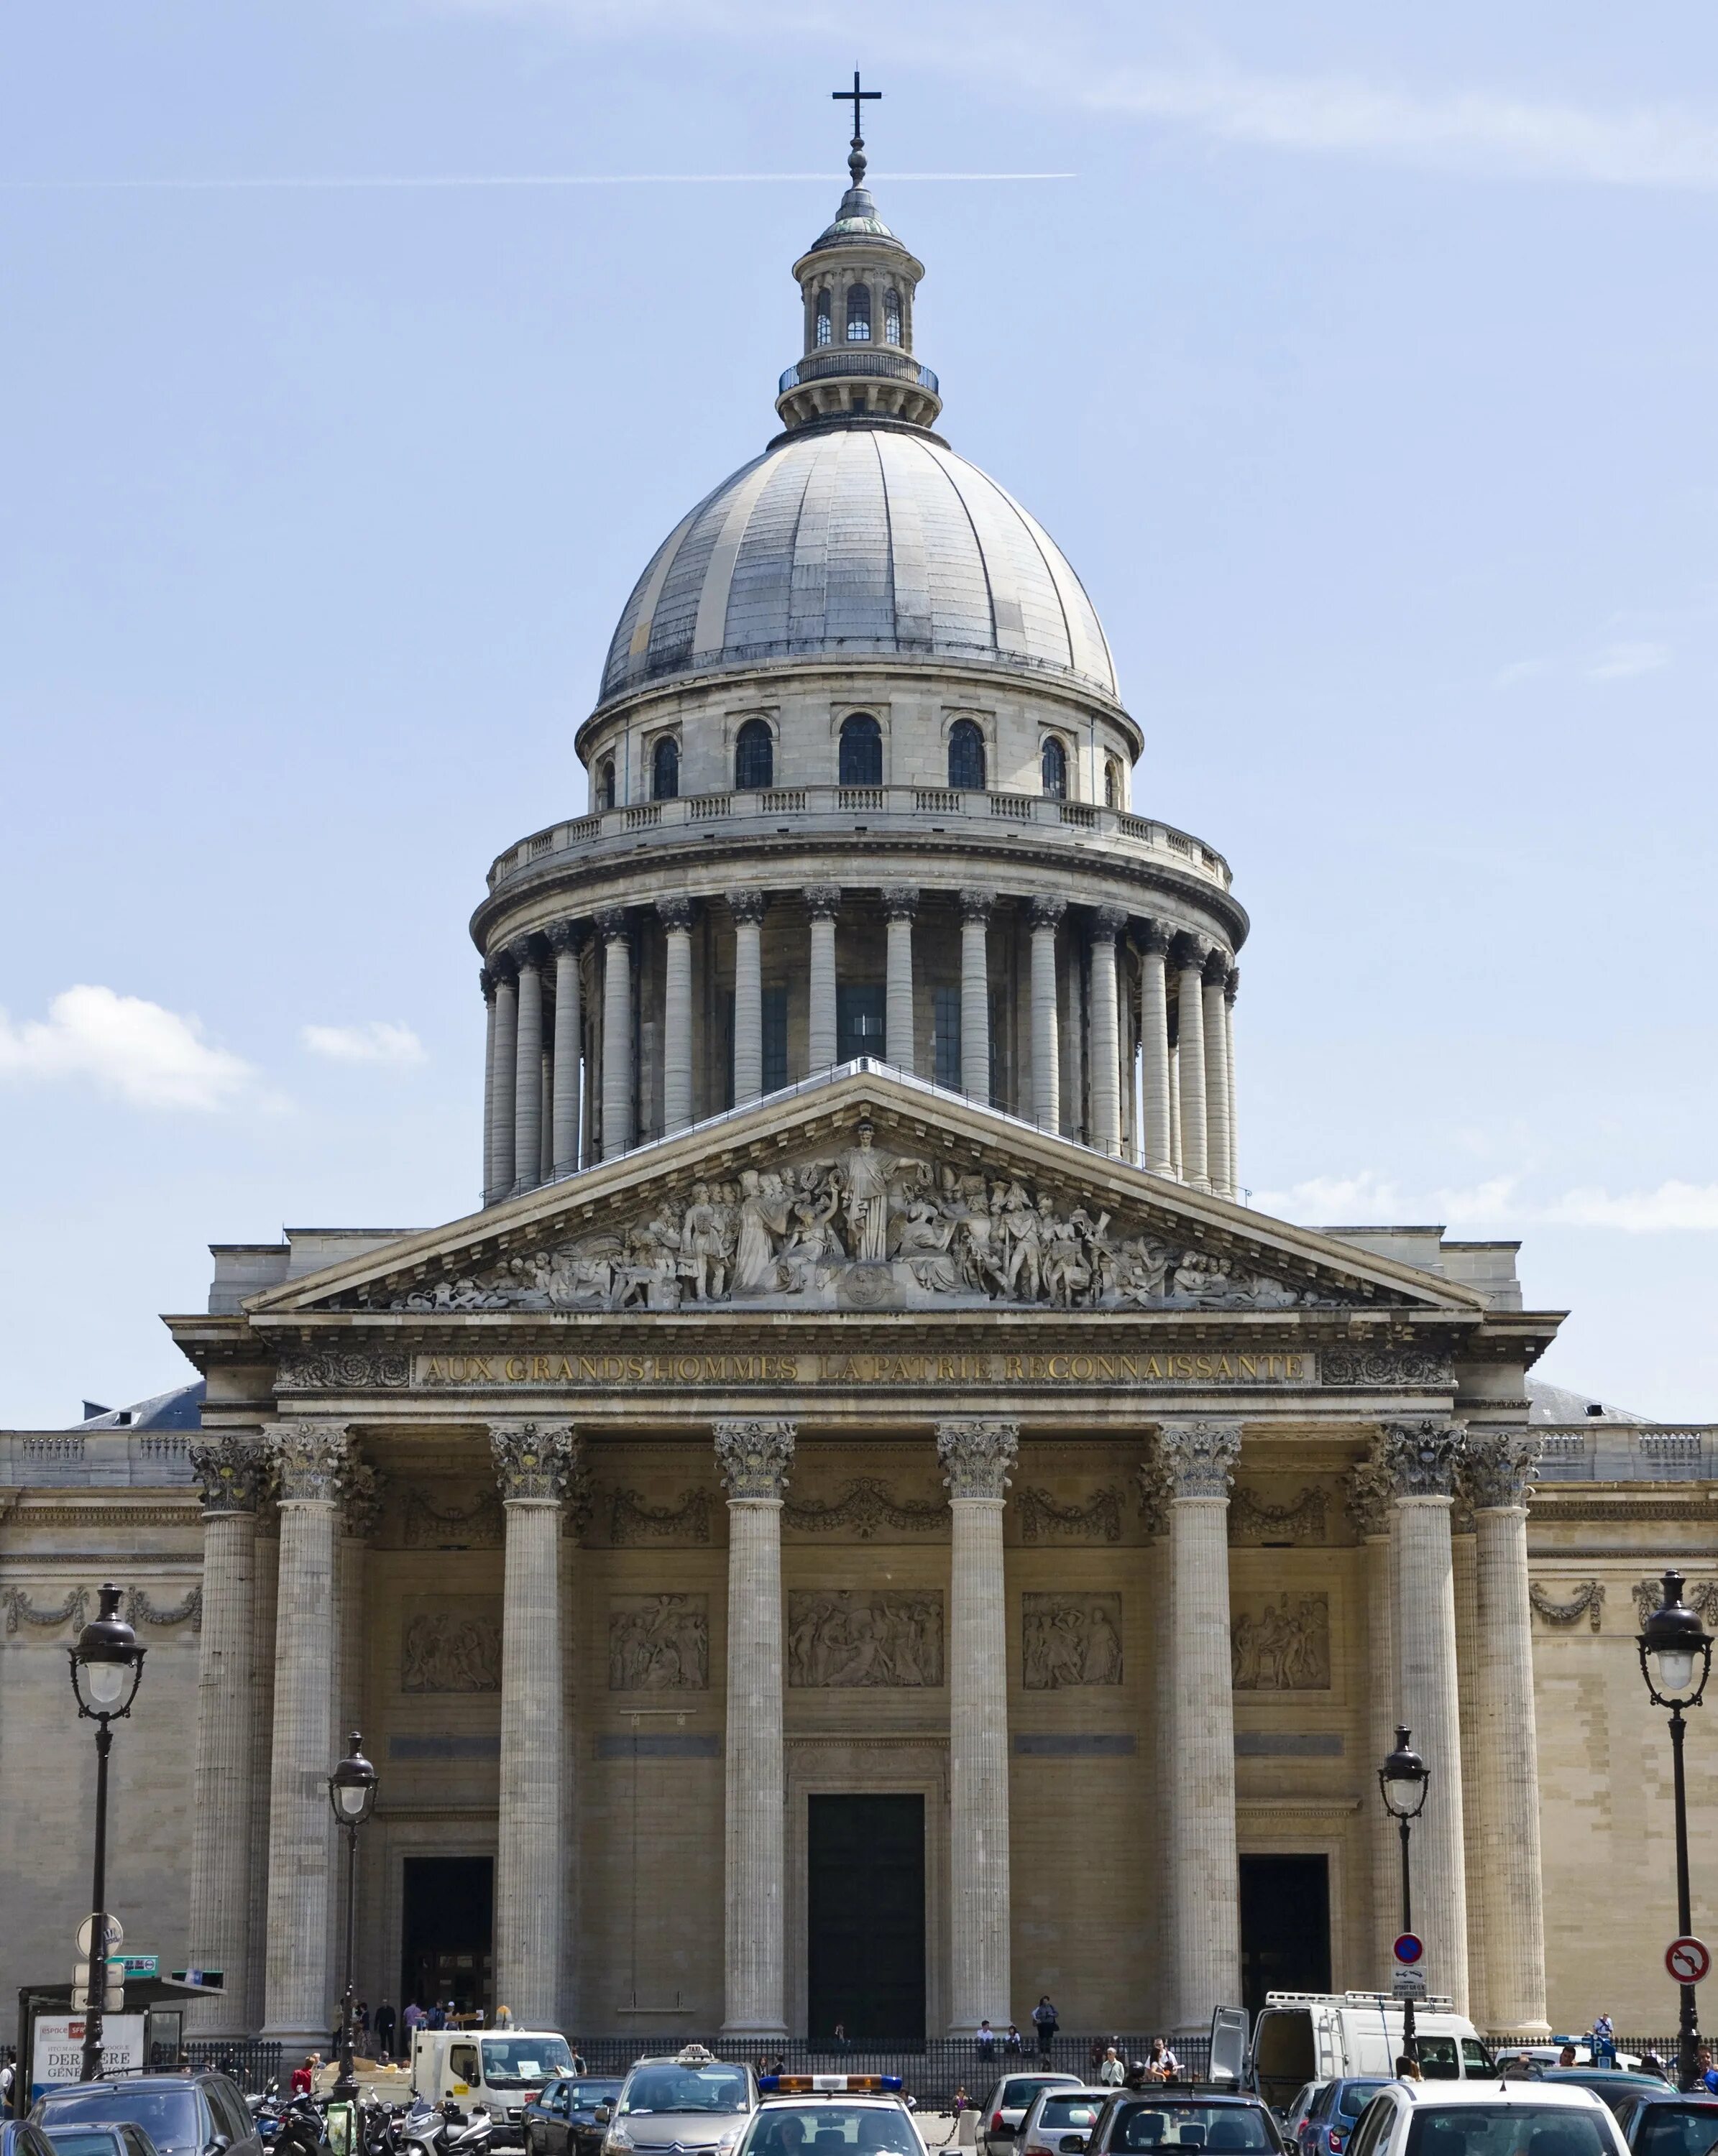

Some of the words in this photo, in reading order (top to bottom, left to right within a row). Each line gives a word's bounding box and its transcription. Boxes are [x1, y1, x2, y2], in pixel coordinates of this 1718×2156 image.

[423, 1355, 496, 1381] AUX
[505, 1355, 644, 1381] GRANDS
[652, 1355, 798, 1381] HOMMES
[818, 1355, 862, 1381] LA
[872, 1355, 993, 1381] PATRIE
[1004, 1355, 1304, 1381] RECONNAISSANTE
[1594, 2040, 1602, 2054] P
